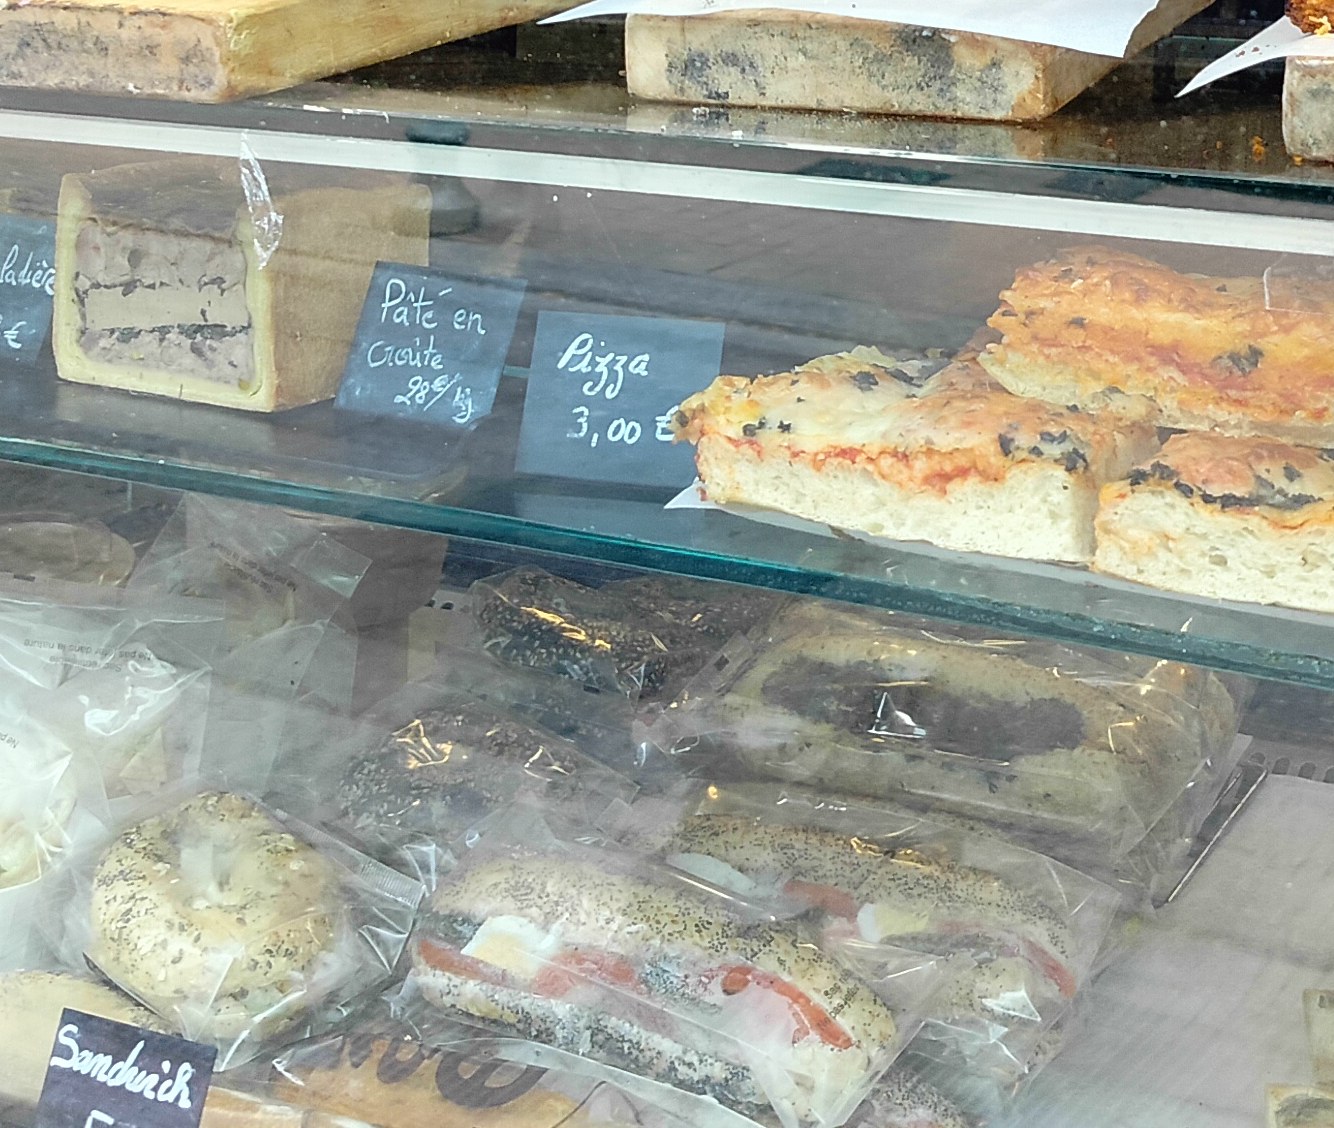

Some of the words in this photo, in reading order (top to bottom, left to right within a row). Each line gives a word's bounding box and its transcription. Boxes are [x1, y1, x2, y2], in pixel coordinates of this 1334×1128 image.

[381, 278, 453, 329] Pâté
[453, 308, 486, 335] en
[557, 333, 650, 399] Pizza
[566, 406, 642, 448] 3,00
[50, 1023, 194, 1109] Sandwich
